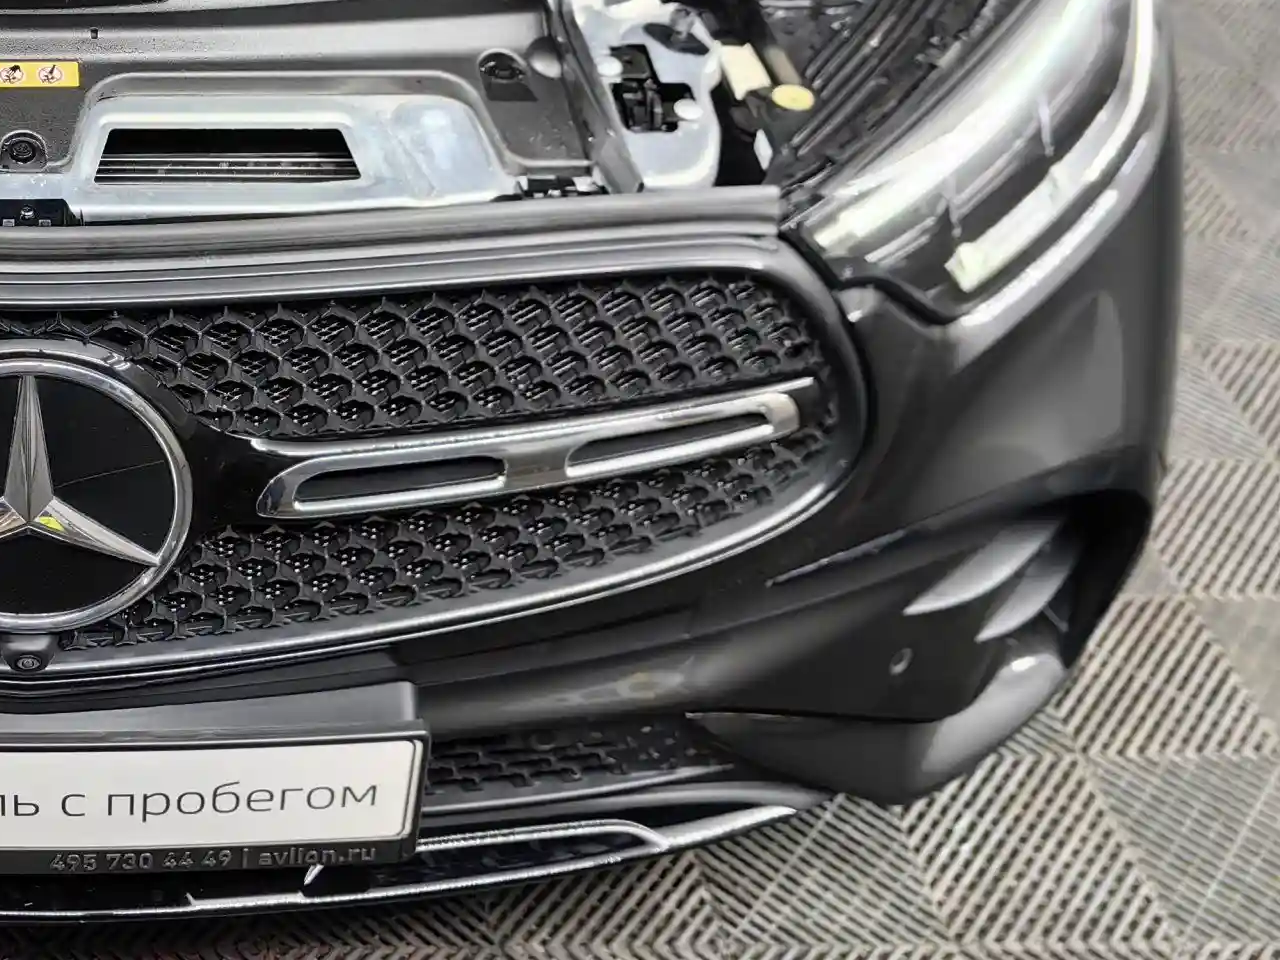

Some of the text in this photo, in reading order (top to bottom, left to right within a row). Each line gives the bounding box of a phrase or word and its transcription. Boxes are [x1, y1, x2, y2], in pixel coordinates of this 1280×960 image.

[60, 793, 86, 817] с
[106, 781, 378, 823] пробегом
[49, 854, 98, 872] 495
[106, 852, 153, 871] 730
[162, 851, 195, 869] 44
[200, 849, 232, 867] 49
[258, 846, 377, 866] avilon.ru
